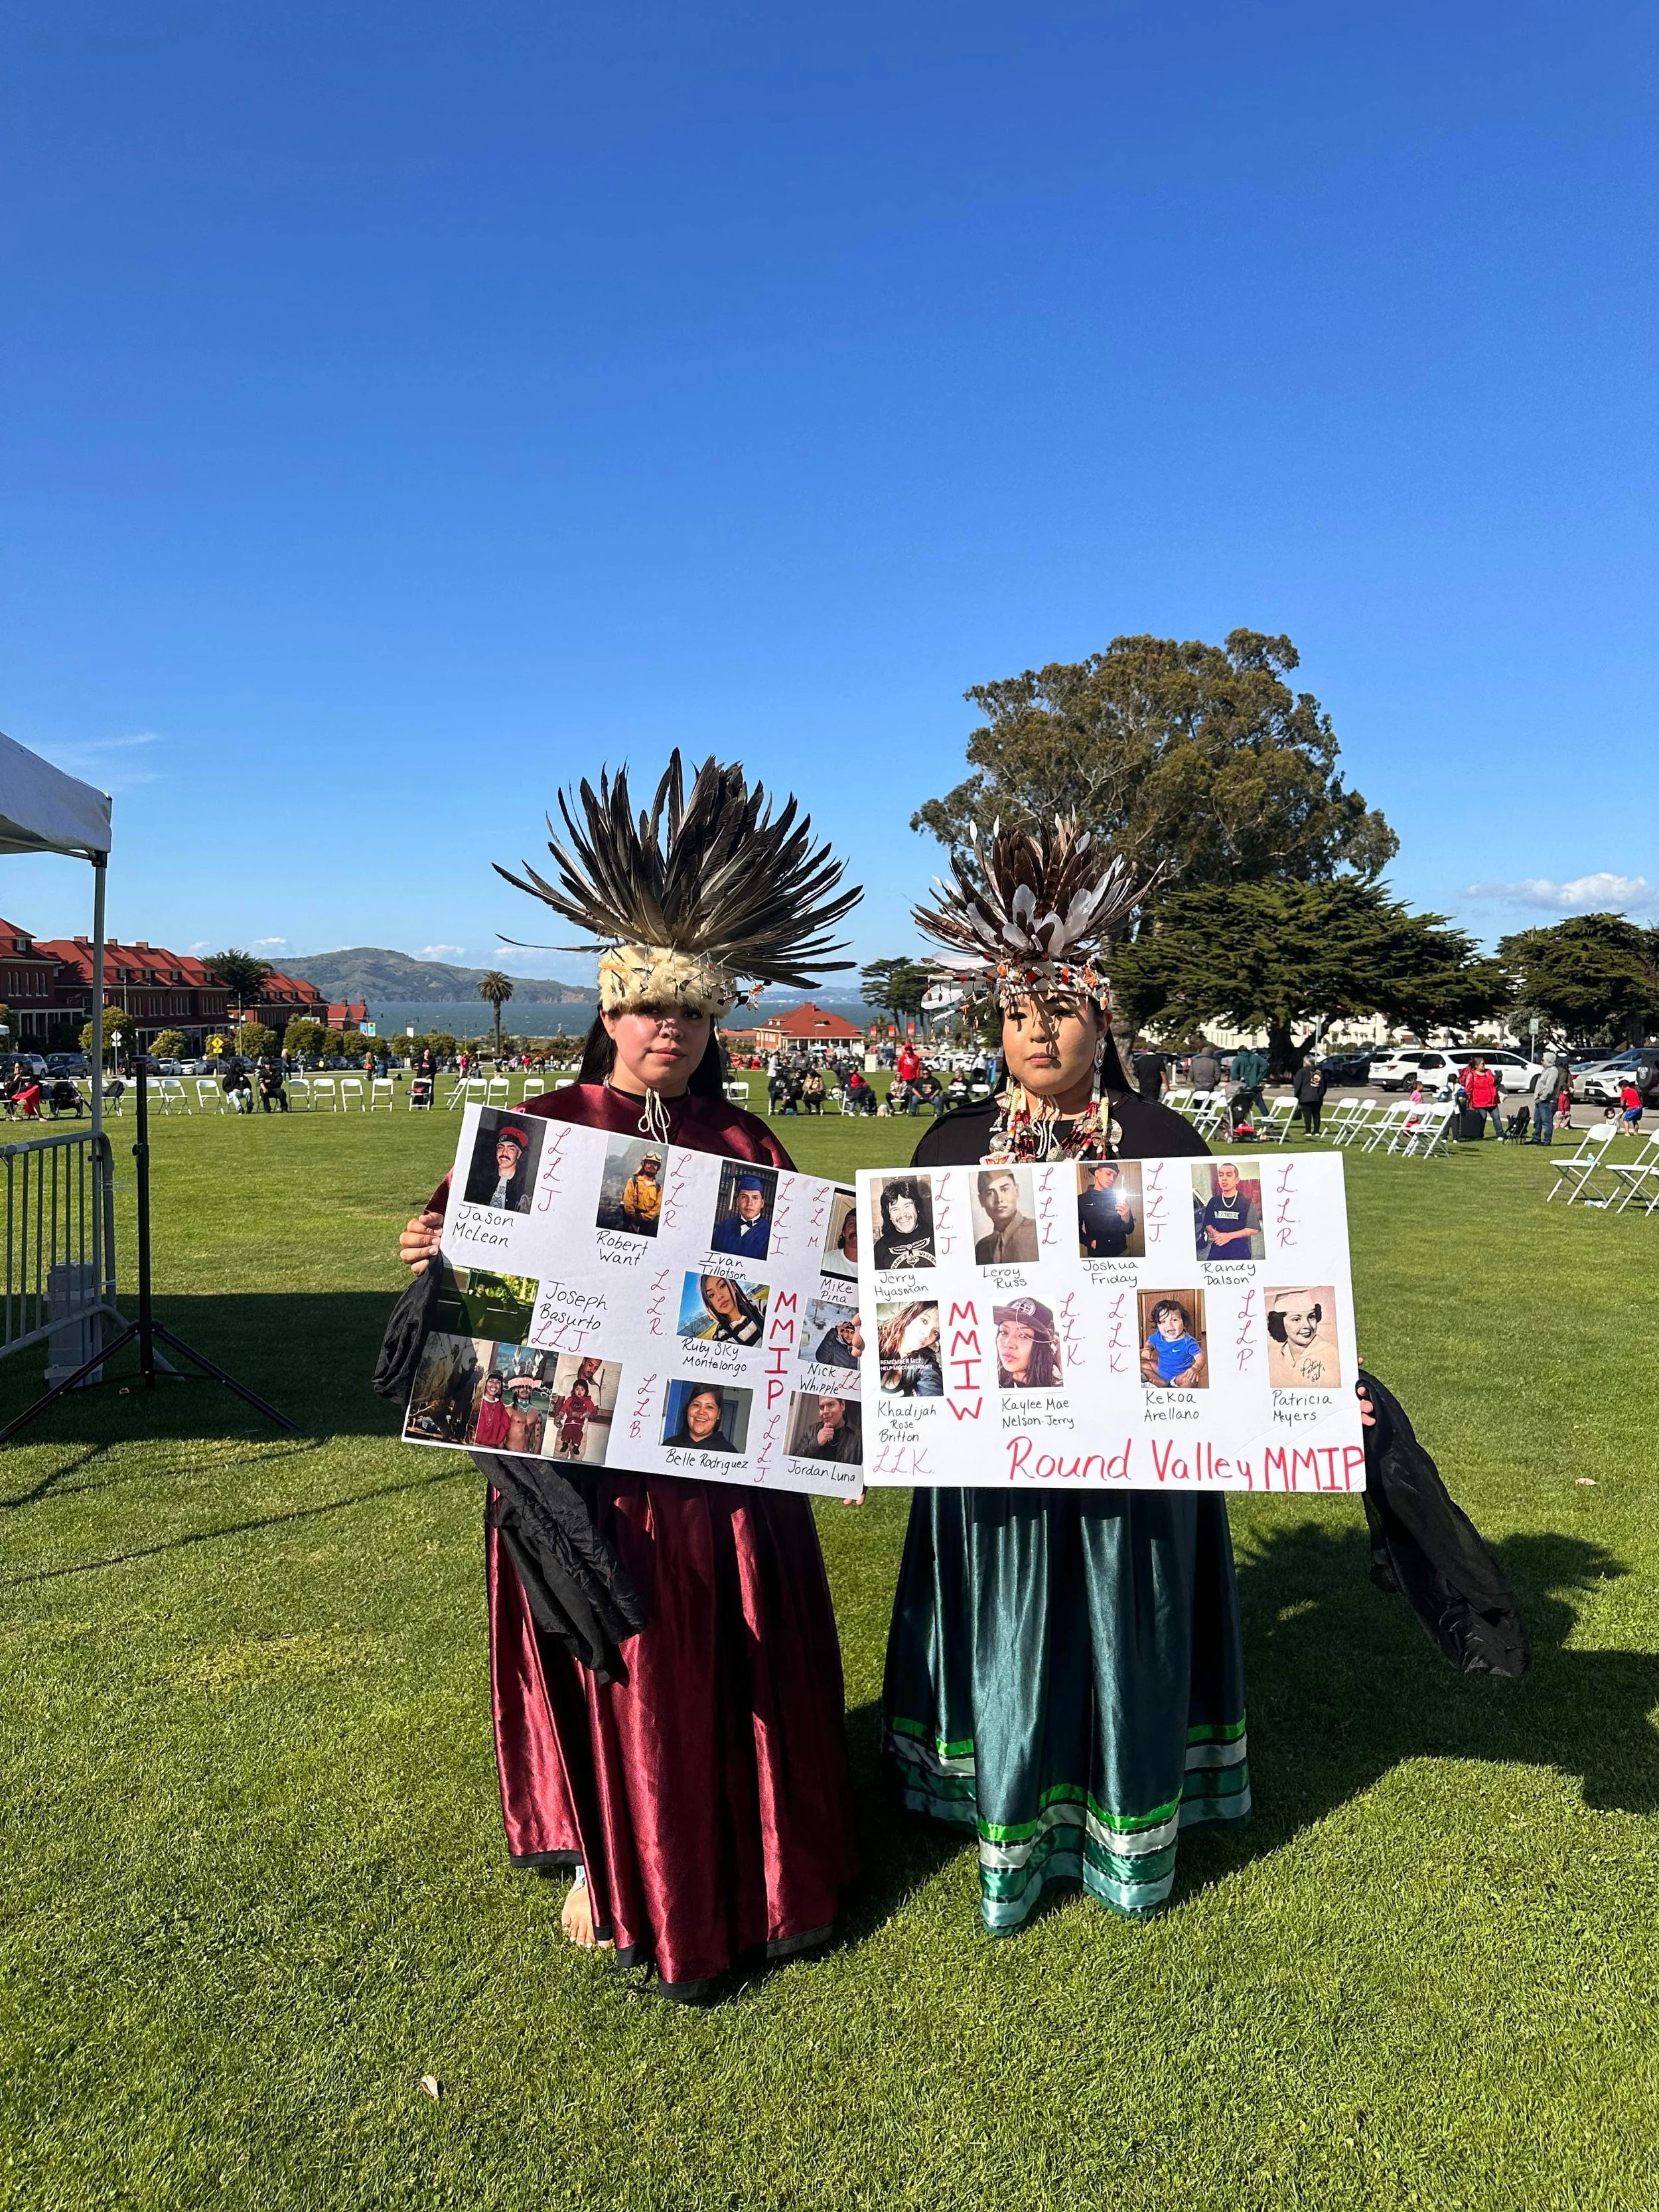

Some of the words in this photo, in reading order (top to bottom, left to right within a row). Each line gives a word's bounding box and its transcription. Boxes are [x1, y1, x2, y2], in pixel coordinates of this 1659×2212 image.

[458, 1203, 514, 1228] Jason
[452, 1221, 508, 1247] McLean
[597, 1230, 649, 1256] Robert
[599, 1248, 642, 1266] Want
[699, 1251, 744, 1268] Ivan
[1081, 1260, 1139, 1271] Joshua
[697, 1262, 747, 1281] Tillotson
[983, 1266, 1020, 1279] Leroy
[1200, 1262, 1256, 1276] Randy
[879, 1272, 916, 1288] Jerry
[993, 1277, 1027, 1288] Russ
[1091, 1273, 1137, 1288] Friday
[1203, 1274, 1251, 1285] Dalson
[545, 1280, 608, 1313] Joseph
[820, 1290, 847, 1303] Pina
[874, 1285, 929, 1301] Hyasman
[540, 1303, 601, 1331] Basurto
[681, 1337, 710, 1358] Ruby
[764, 1291, 798, 1410] MMIP
[682, 1355, 747, 1377] Montelongo
[946, 1301, 983, 1421] MMIW
[807, 1363, 837, 1378] Nick
[800, 1374, 839, 1395] Whipple
[1002, 1398, 1042, 1416] Kaylee
[1046, 1398, 1070, 1410] Mae
[1272, 1389, 1333, 1407] Patricia
[878, 1400, 936, 1421] Khadijah
[1144, 1407, 1199, 1422] Arellano
[1273, 1410, 1317, 1428] Meyers
[890, 1419, 914, 1430] Rose
[879, 1428, 918, 1443] Britton
[666, 1447, 695, 1466] Belle
[699, 1453, 749, 1475] Rodriguez
[1006, 1436, 1132, 1481] Round
[1151, 1439, 1253, 1491] Valley
[1264, 1445, 1366, 1493] MMIP
[788, 1458, 828, 1477] Jordan
[831, 1464, 856, 1483] Luna
